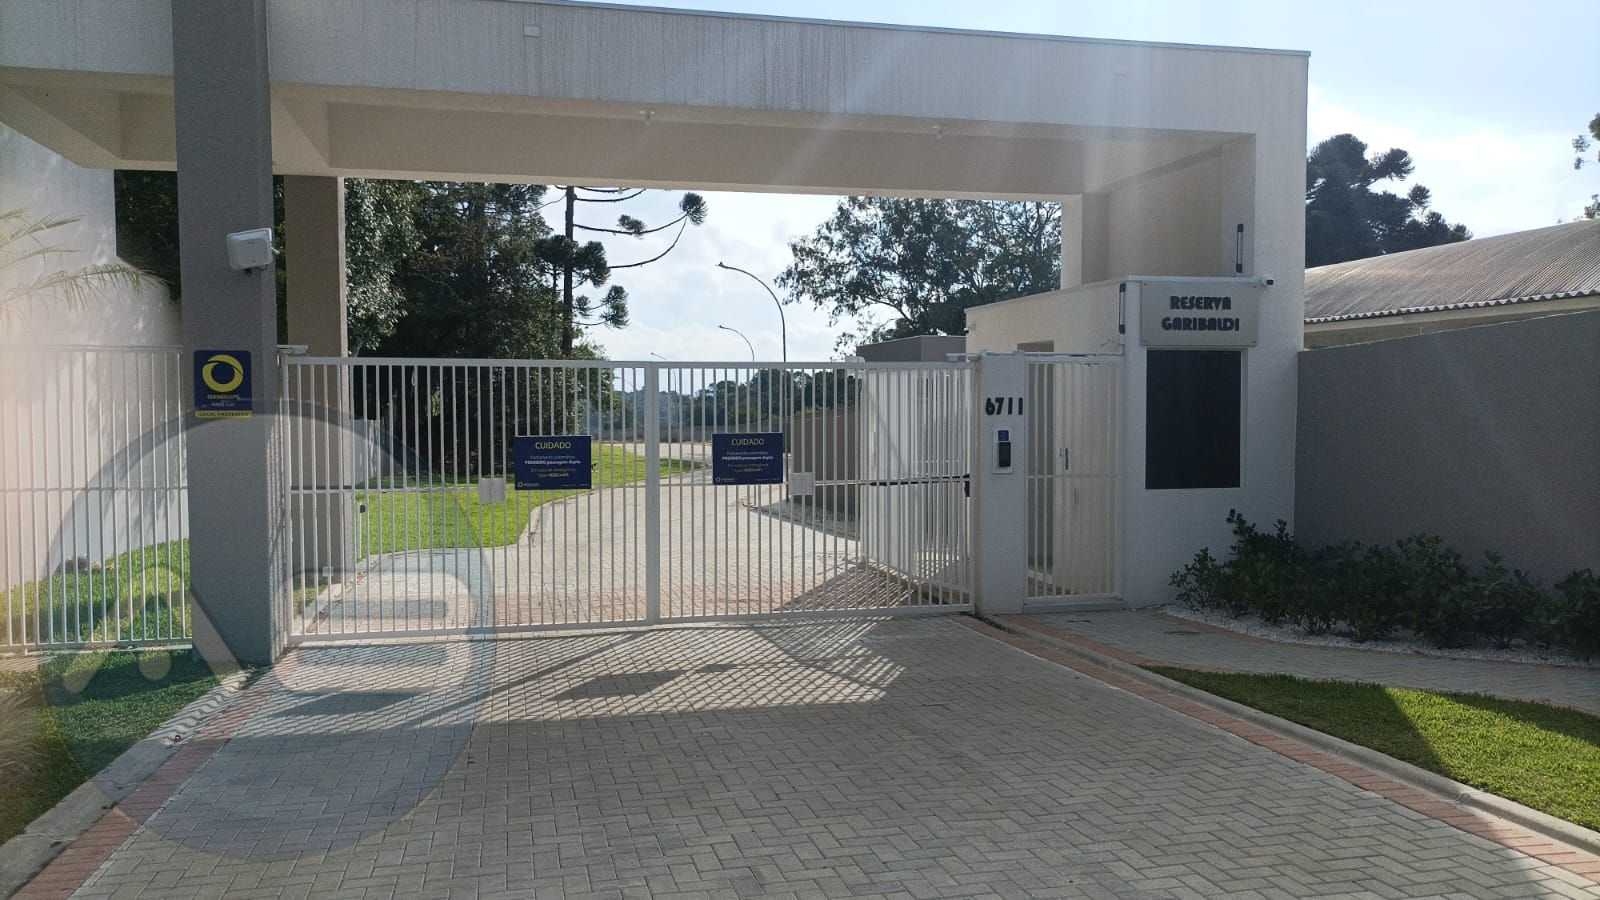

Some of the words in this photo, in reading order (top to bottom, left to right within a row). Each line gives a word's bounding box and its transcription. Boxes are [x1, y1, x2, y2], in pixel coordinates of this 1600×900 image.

[1170, 296, 1231, 310] RESERVA
[1161, 317, 1240, 332] GARIBALDI
[985, 397, 1023, 415] 6711
[535, 441, 571, 450] CUIDADO
[731, 438, 764, 446] CUIDADO
